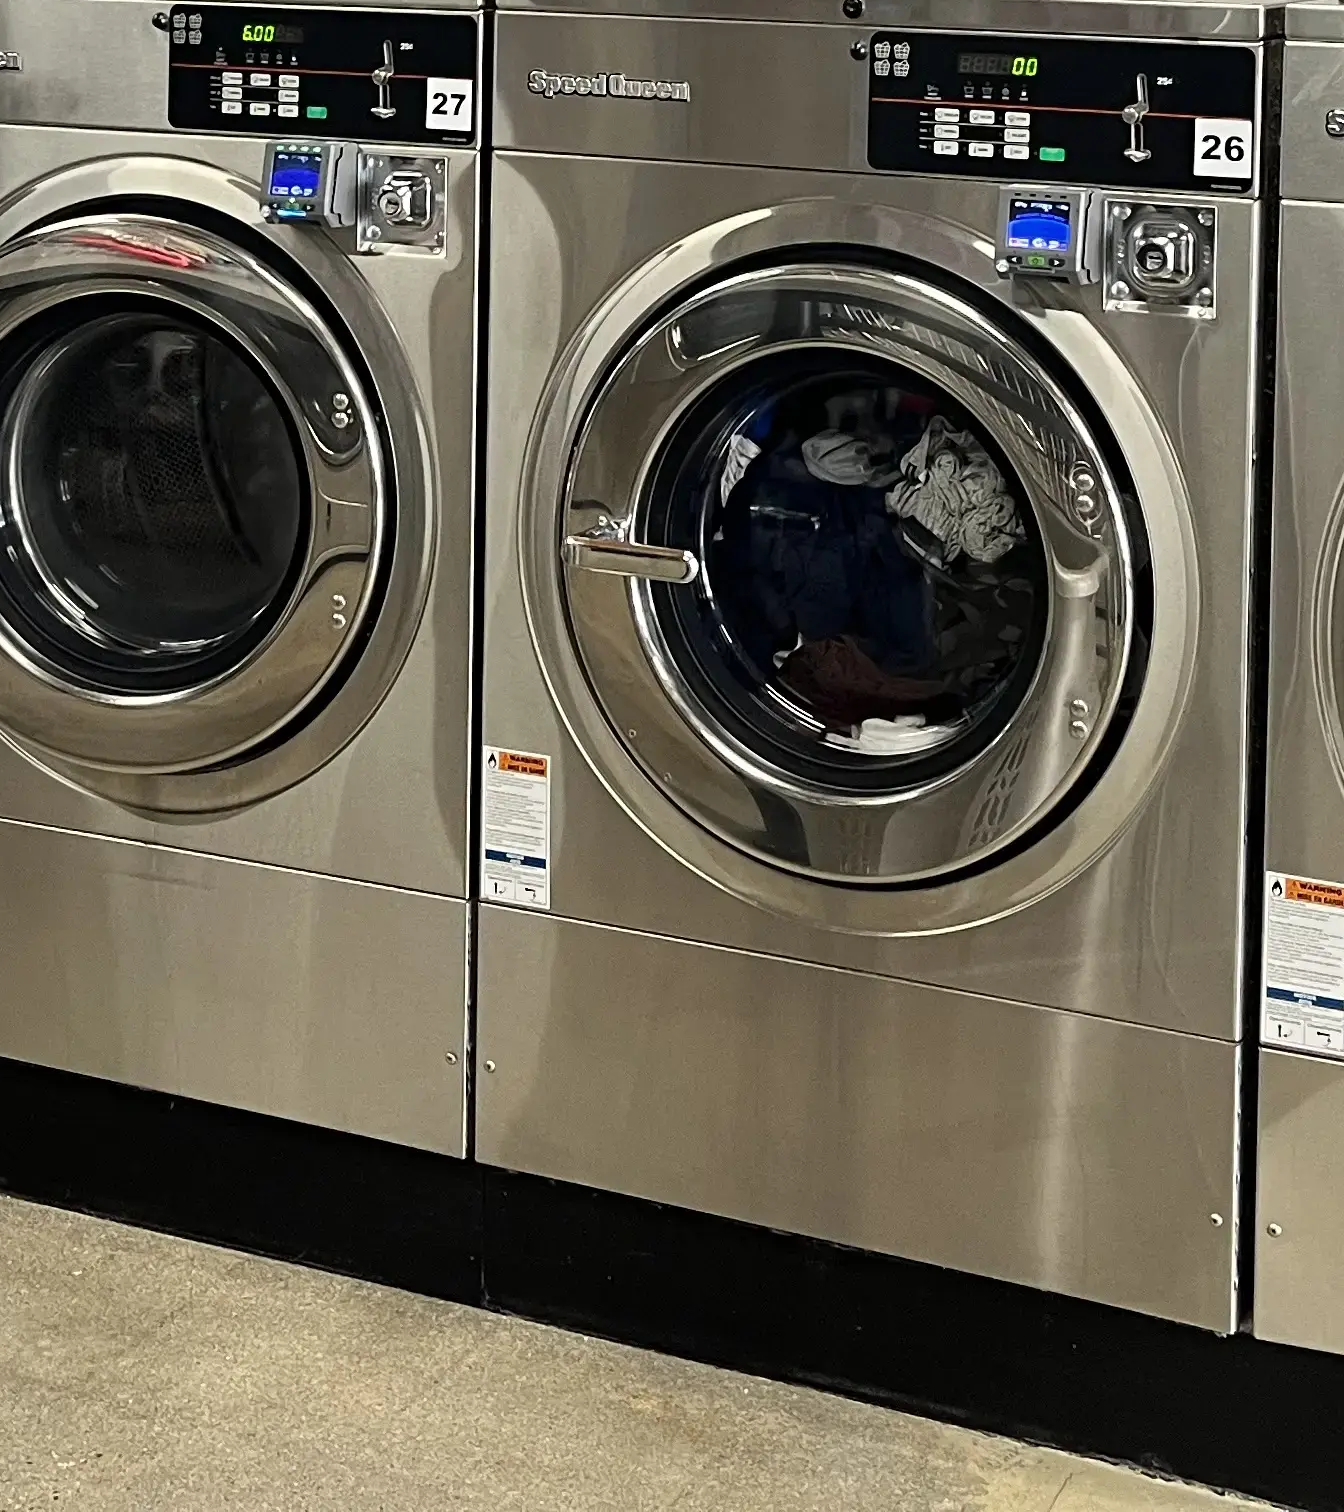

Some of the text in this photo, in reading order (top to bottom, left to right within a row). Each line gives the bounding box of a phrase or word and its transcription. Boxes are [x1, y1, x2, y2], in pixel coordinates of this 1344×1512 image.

[527, 69, 691, 103] Speed Queen
[432, 92, 466, 116] 27
[1201, 135, 1245, 162] 26
[1299, 881, 1343, 896] WARNING
